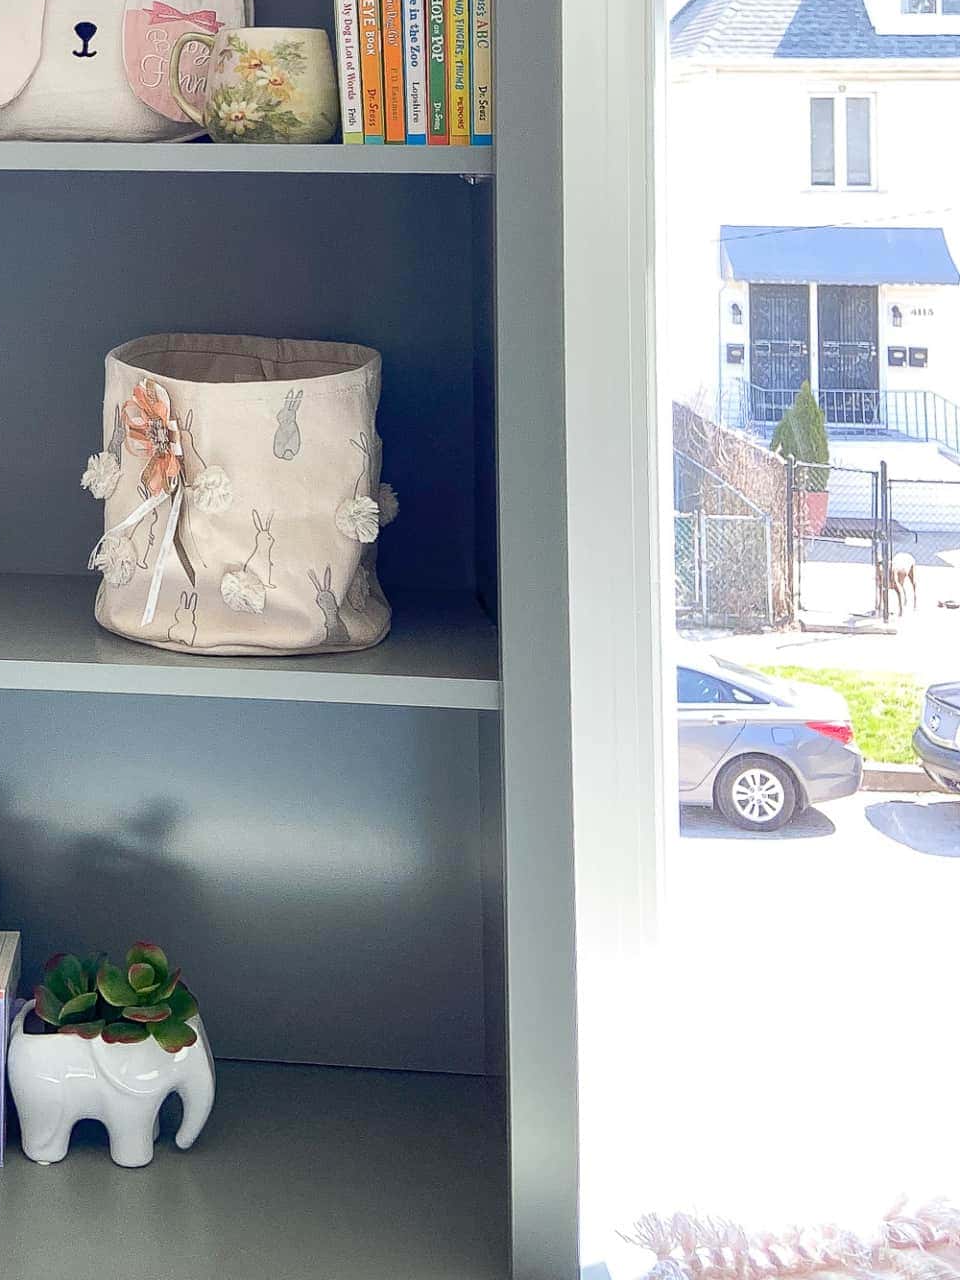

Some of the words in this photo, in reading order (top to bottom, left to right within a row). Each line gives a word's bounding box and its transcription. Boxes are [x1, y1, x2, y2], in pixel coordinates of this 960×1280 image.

[341, 4, 352, 16] My
[362, 0, 375, 26] EYE
[410, 9, 420, 20] in
[343, 19, 354, 36] Dog
[410, 24, 420, 42] the
[434, 24, 440, 34] on
[477, 20, 490, 48] ABC
[345, 46, 354, 59] Lot
[410, 46, 420, 67] Zoo
[431, 34, 444, 62] POP
[347, 62, 356, 71] of
[455, 60, 464, 90] THUMB
[346, 72, 356, 100] Words
[368, 89, 377, 101] Dr.
[478, 86, 488, 97] Dr.
[410, 82, 421, 123] Lopshire
[434, 102, 442, 113] Dr.
[479, 100, 488, 120] Seuss
[348, 108, 357, 126] Frith
[368, 103, 379, 126] Seuss
